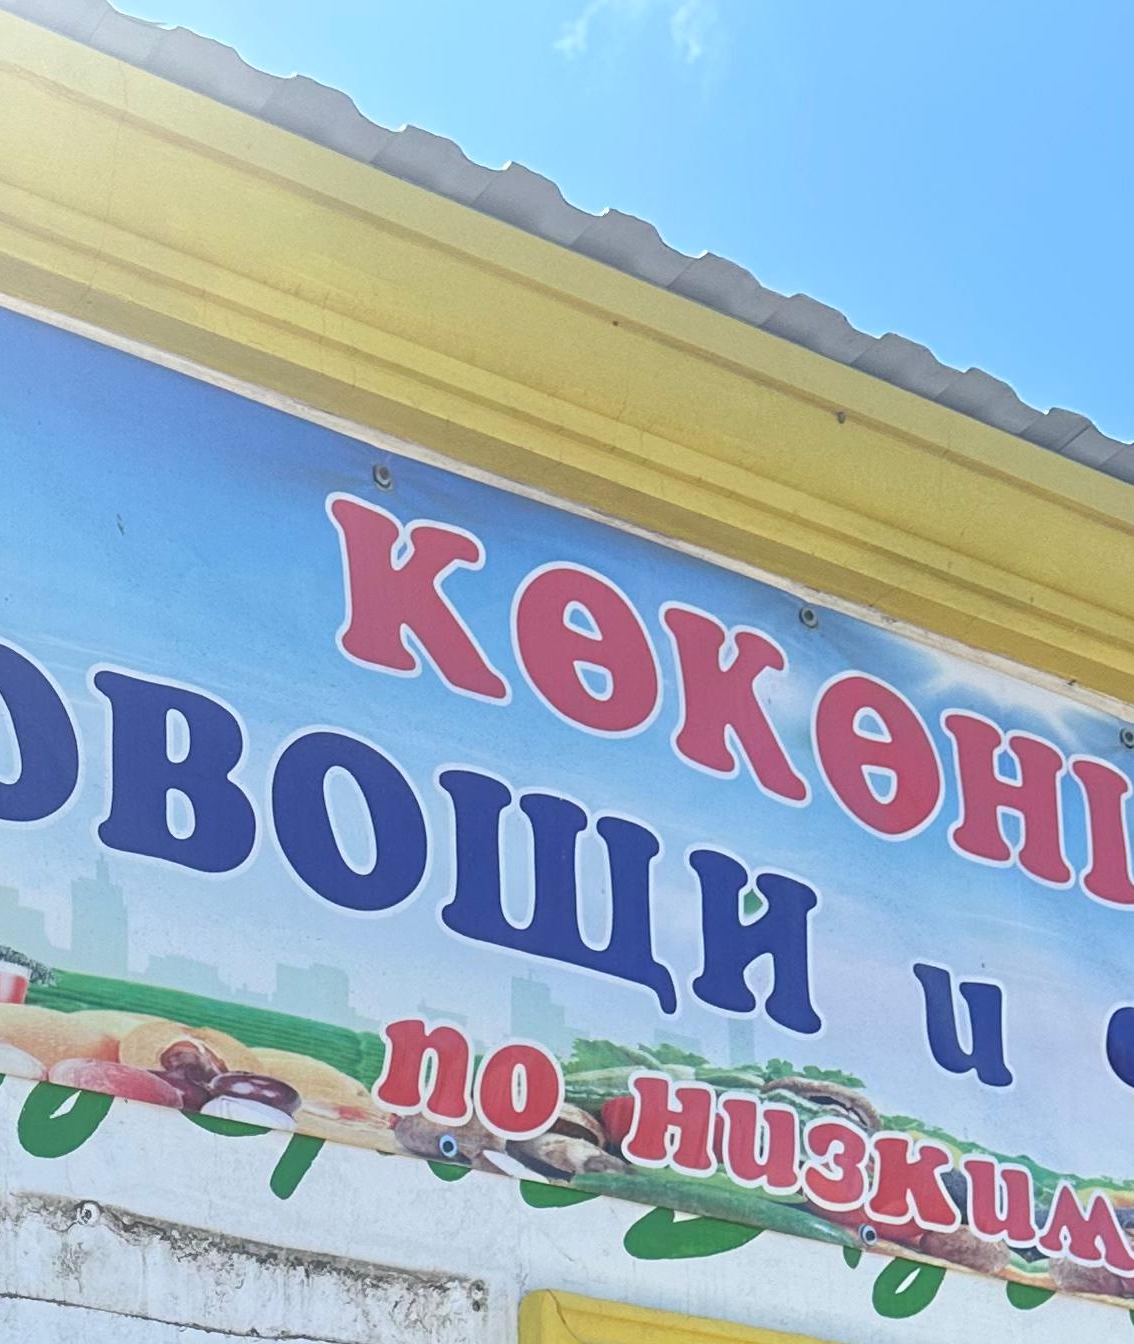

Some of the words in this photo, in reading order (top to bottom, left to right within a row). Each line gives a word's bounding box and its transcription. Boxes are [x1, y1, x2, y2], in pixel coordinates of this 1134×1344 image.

[912, 962, 1015, 1088] и
[377, 1020, 563, 1137] по
[625, 1077, 1134, 1271] низким
